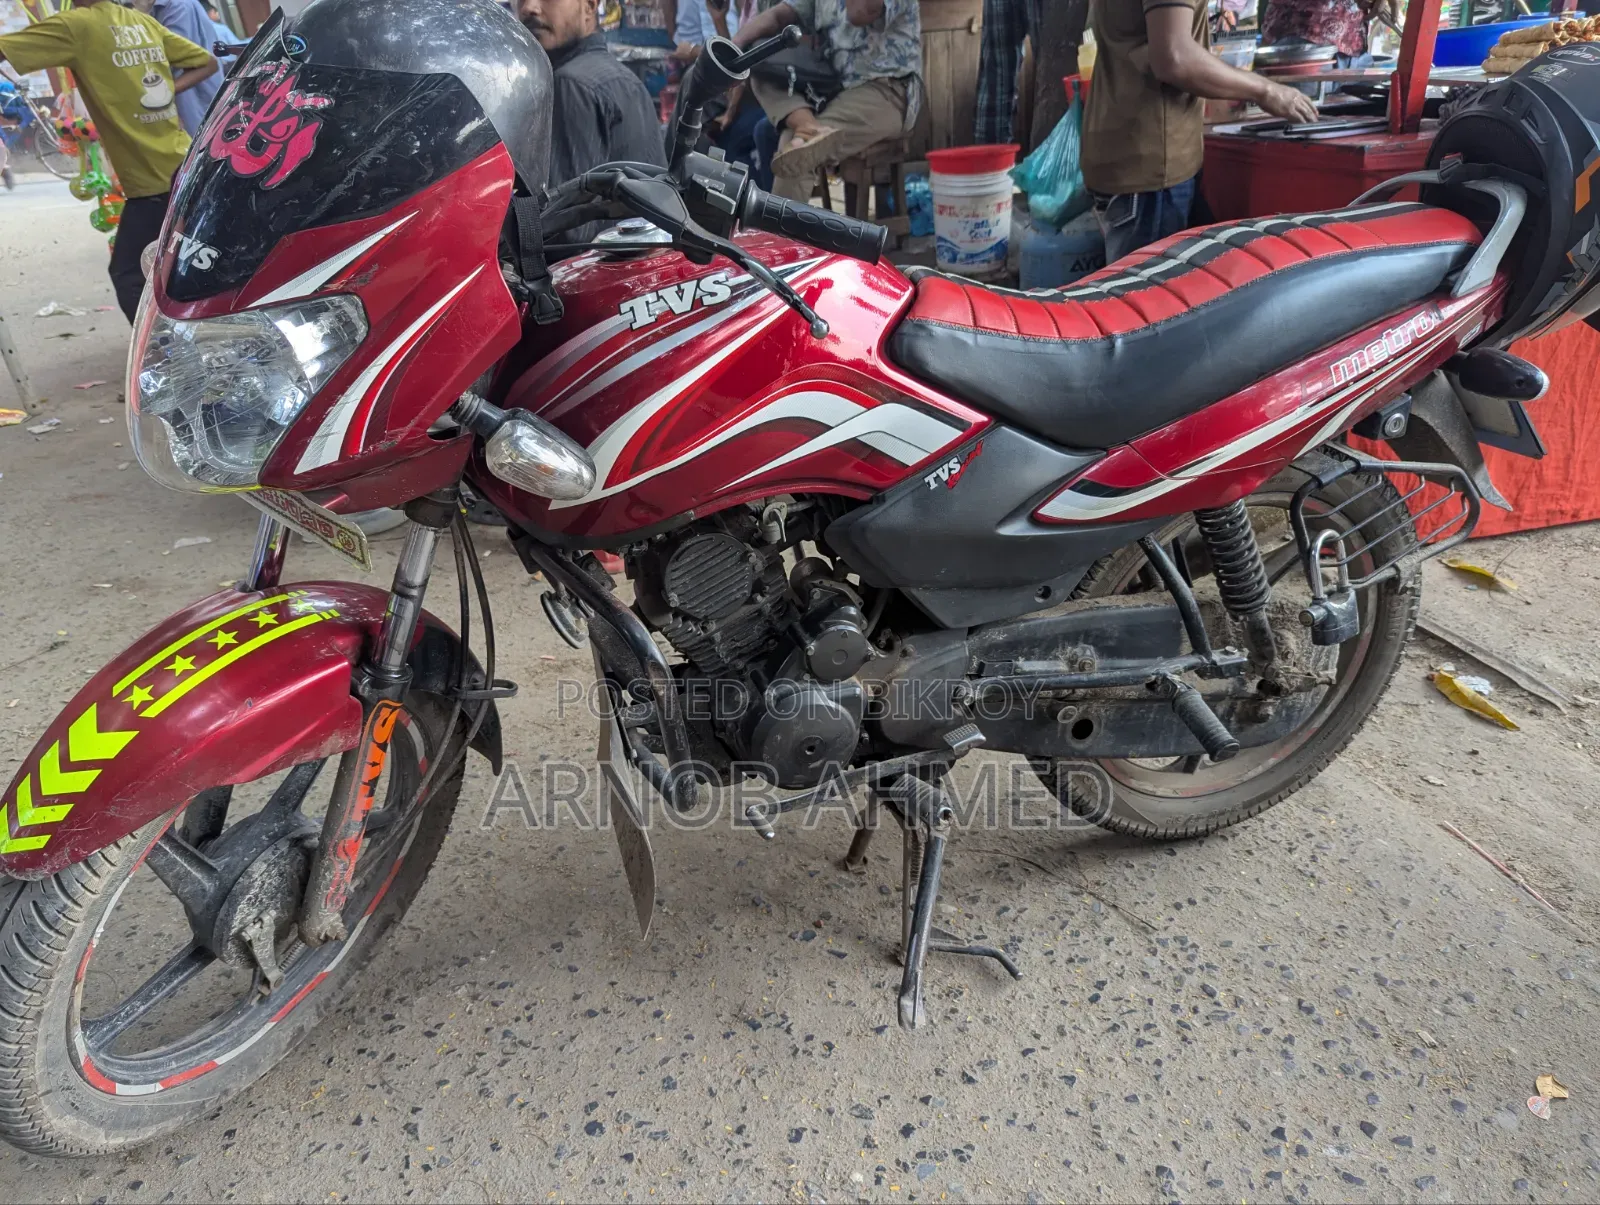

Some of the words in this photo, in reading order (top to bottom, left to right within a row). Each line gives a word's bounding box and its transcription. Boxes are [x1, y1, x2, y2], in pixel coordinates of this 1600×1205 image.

[112, 46, 166, 67] COFFEE
[168, 231, 219, 270] TVS
[619, 272, 732, 331] TVS
[1330, 311, 1435, 387] metro
[924, 456, 961, 490] TVS
